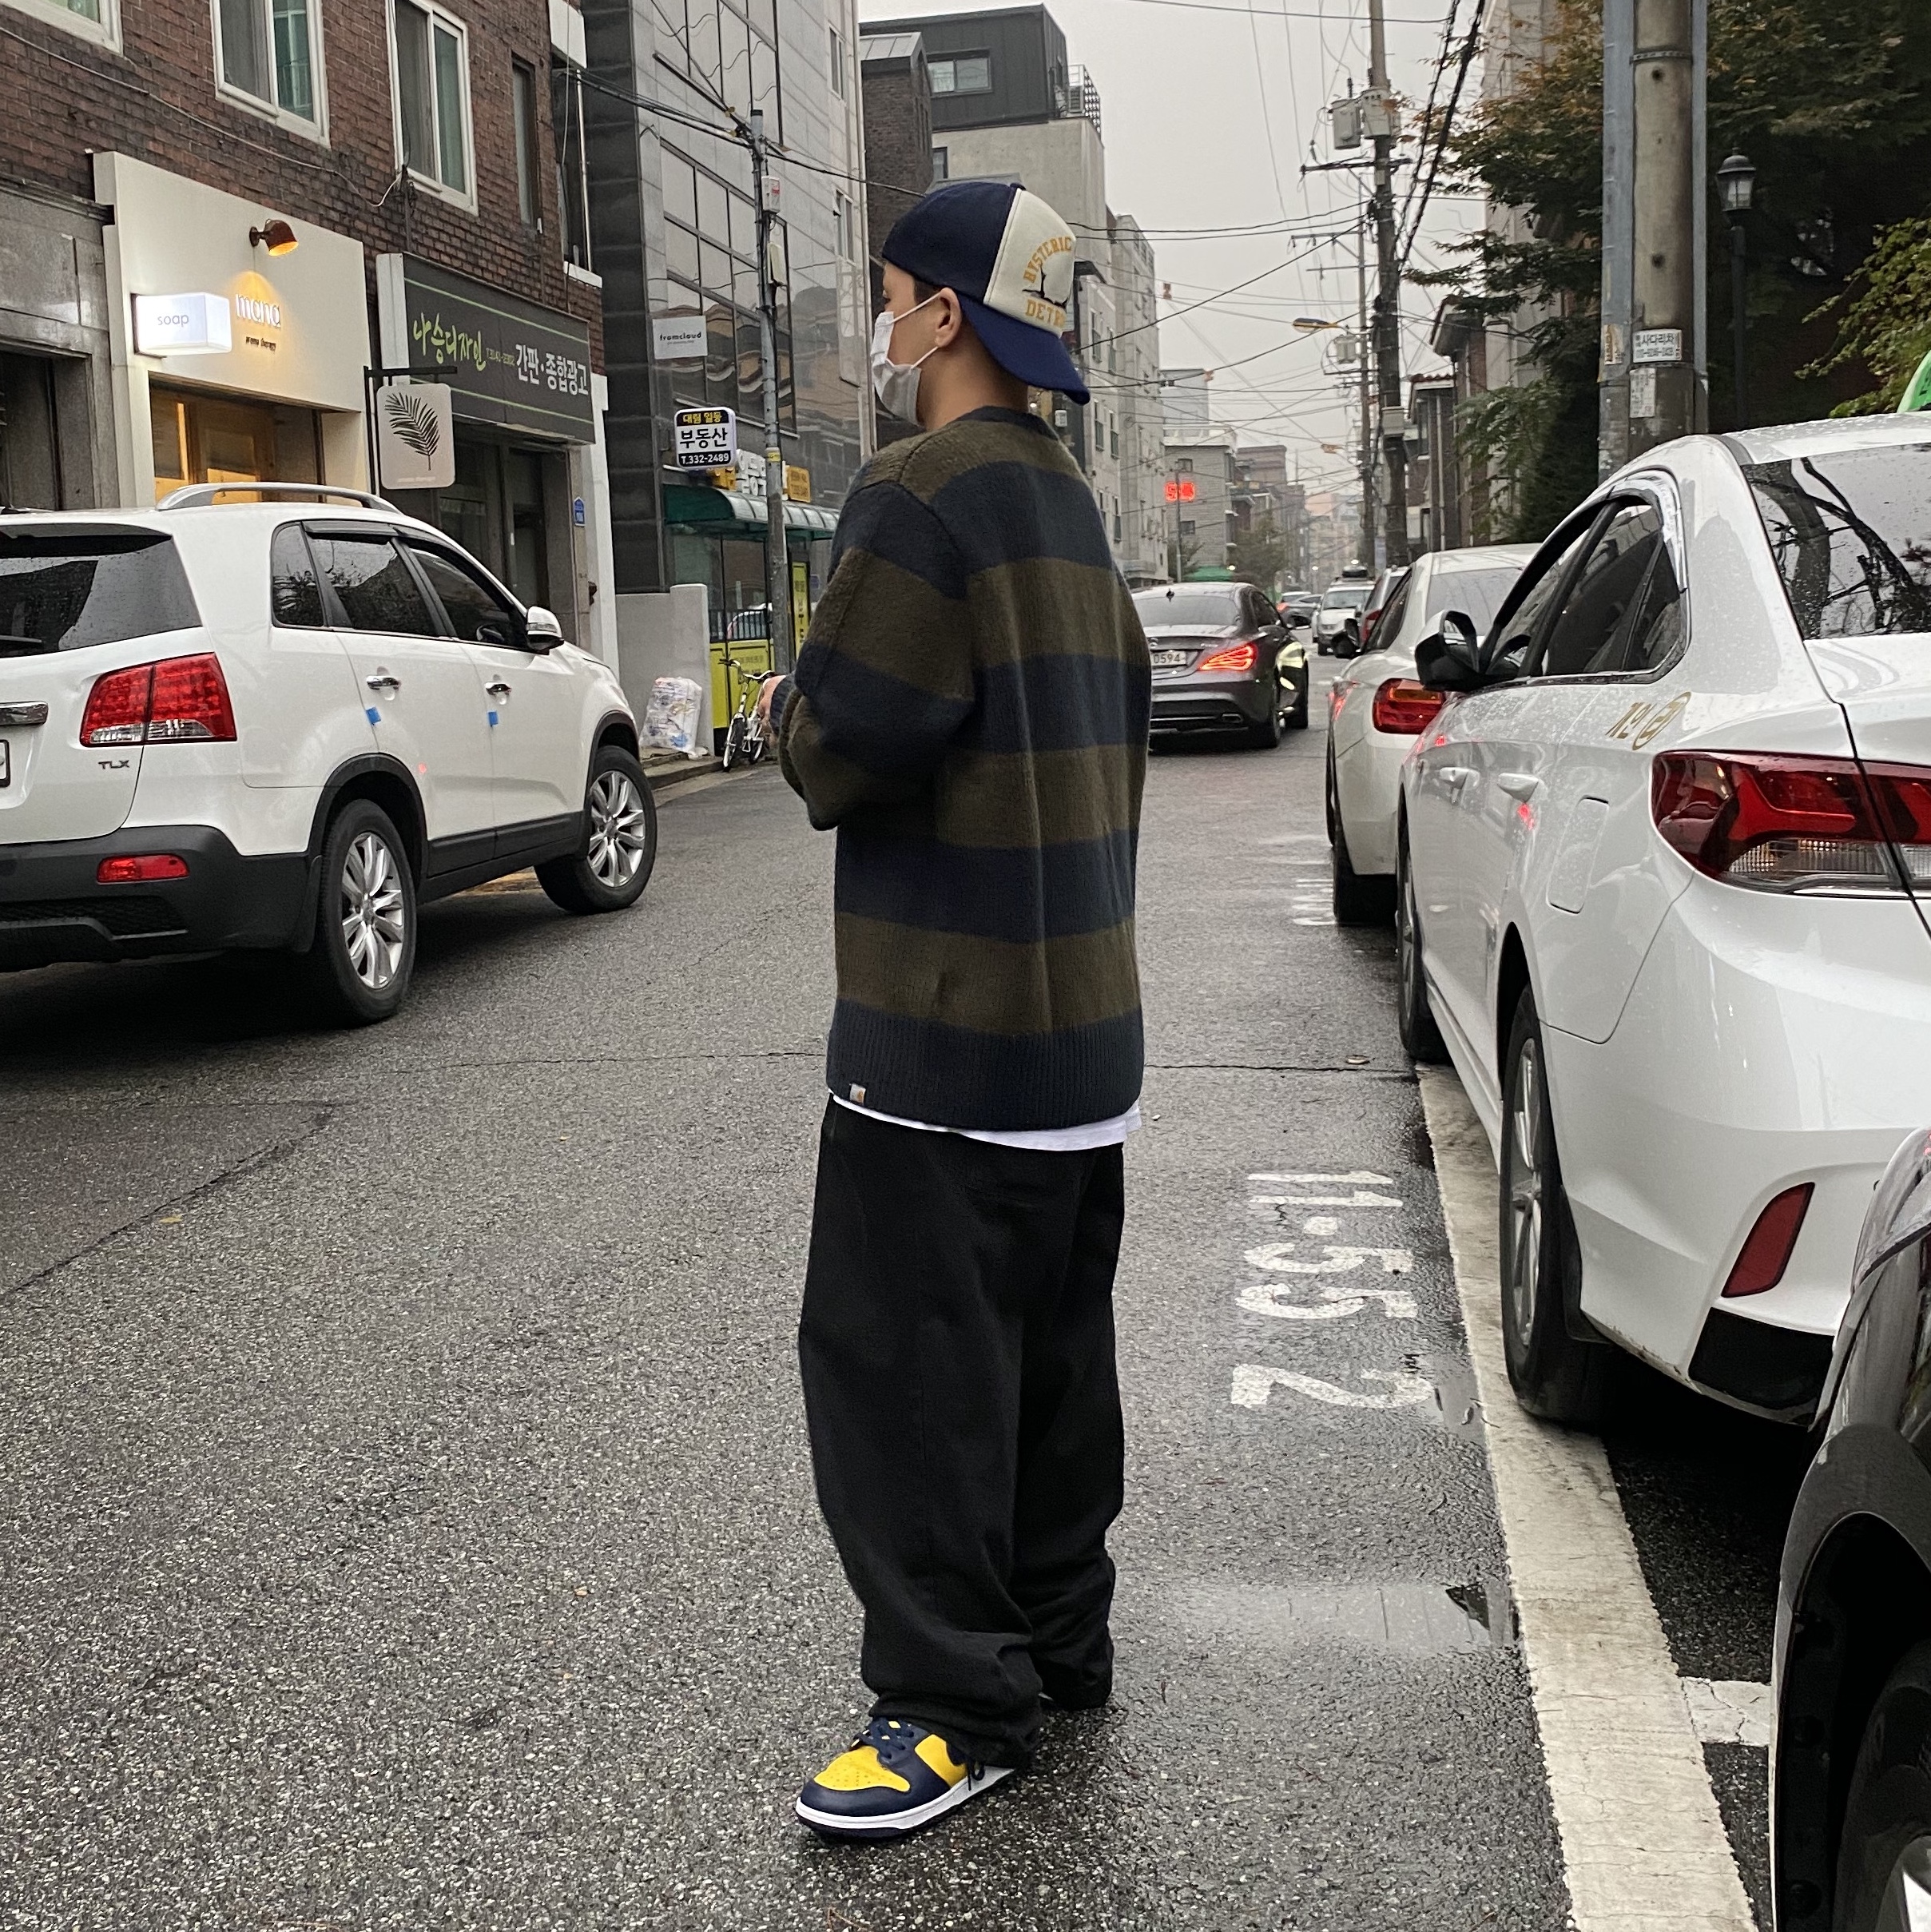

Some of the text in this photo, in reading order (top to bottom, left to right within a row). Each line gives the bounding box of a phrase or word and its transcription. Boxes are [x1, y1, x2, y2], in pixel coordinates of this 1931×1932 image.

[157, 314, 189, 327] soap
[660, 332, 701, 341] fromcloud
[680, 427, 728, 449] 부동산
[1154, 653, 1180, 664] 0594
[98, 759, 130, 769] TLX
